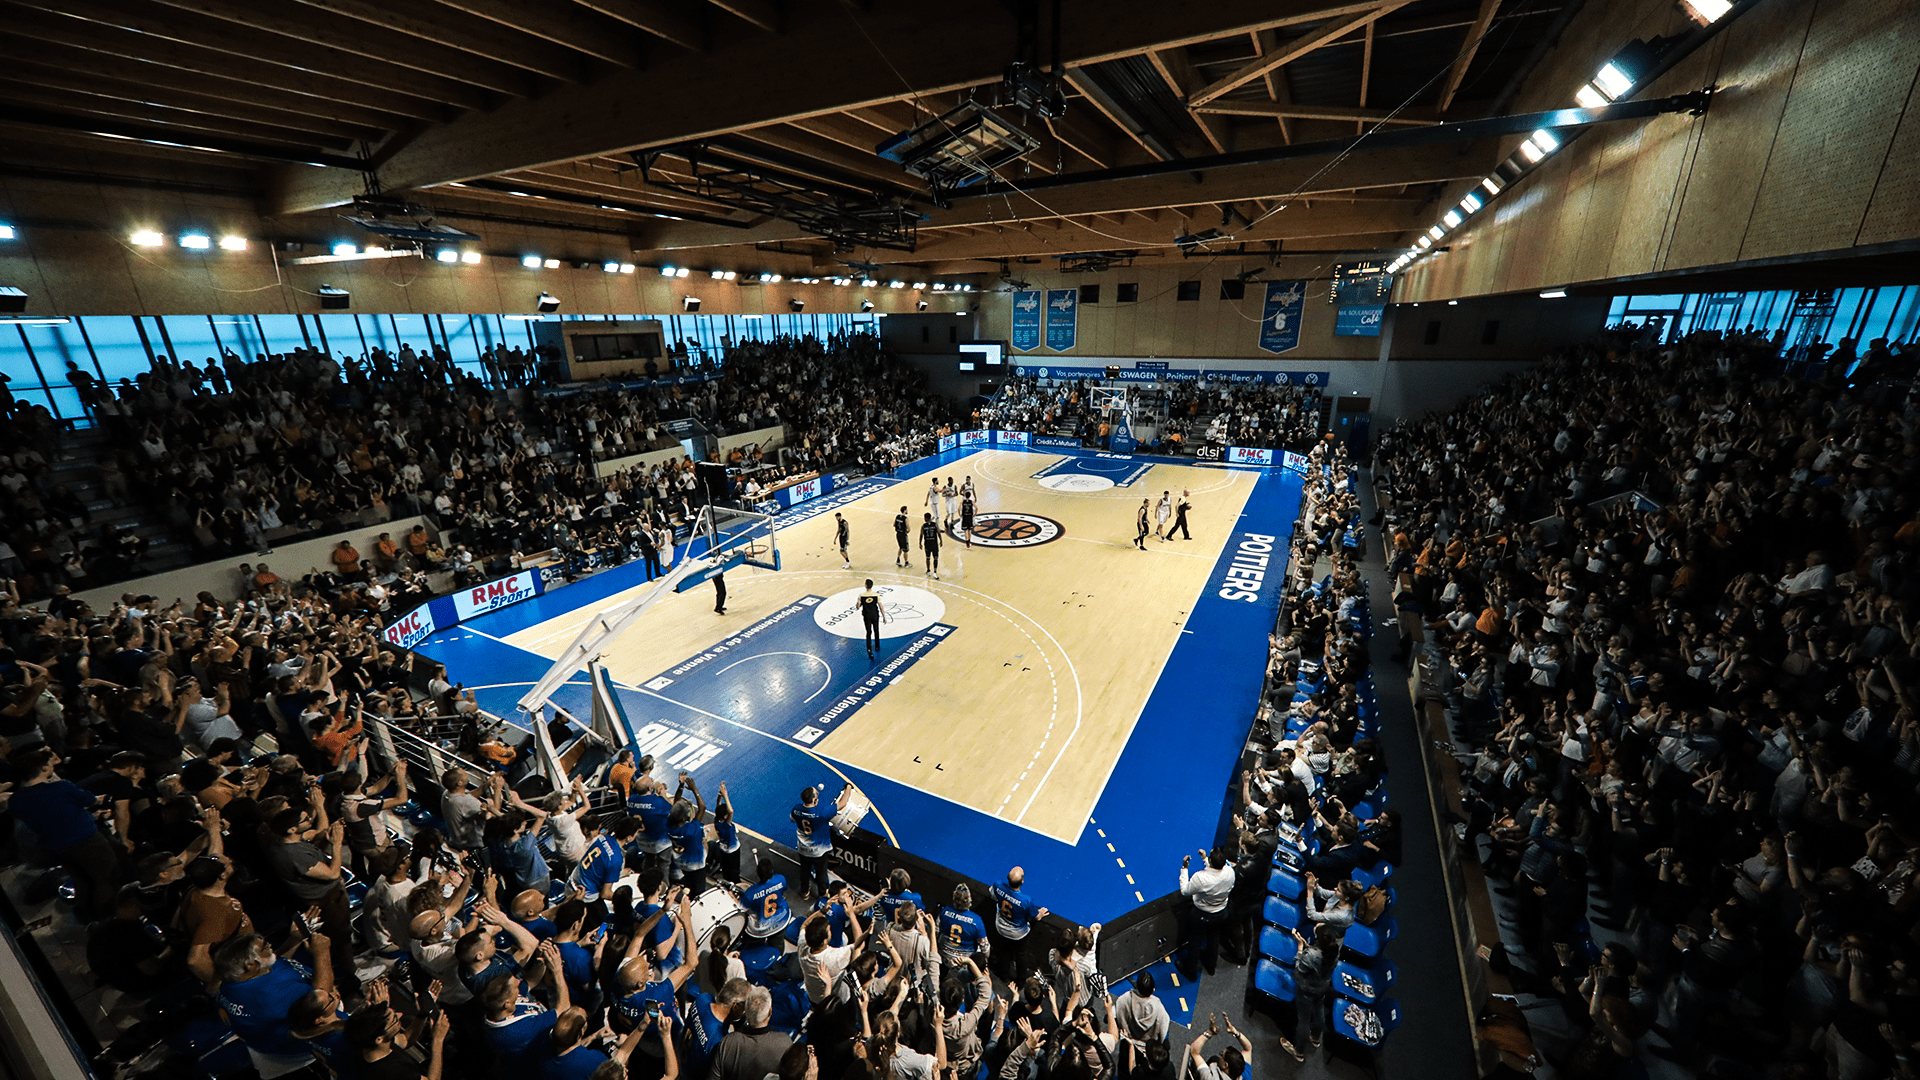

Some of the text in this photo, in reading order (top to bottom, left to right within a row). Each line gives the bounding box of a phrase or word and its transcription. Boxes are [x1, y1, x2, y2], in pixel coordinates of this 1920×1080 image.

[1275, 313, 1286, 330] 6
[1361, 314, 1380, 325] Café
[1056, 369, 1067, 377] Vos
[1068, 370, 1100, 379] partenaires
[1102, 371, 1157, 379] VKSWAGEN
[966, 430, 984, 440] RMC
[1003, 432, 1022, 441] RMC
[1196, 446, 1219, 457] dlsi
[1239, 448, 1264, 459] RMC
[1244, 456, 1270, 464] SPORT
[1289, 453, 1305, 466] RMC
[796, 481, 815, 496] RMC
[837, 484, 887, 503] GRAND
[765, 501, 842, 530] POITIERS
[1219, 533, 1276, 603] POITIERS
[472, 576, 519, 606] RMC
[490, 587, 532, 610] SPORT
[387, 611, 421, 644] RMC
[403, 622, 431, 650] SPORT
[672, 605, 803, 676] Département de la Vienne
[818, 636, 936, 724] Département de la Vienne
[801, 819, 813, 835] 6
[581, 847, 602, 870] 6
[830, 846, 878, 874] zon.fr
[752, 889, 766, 901] ALLEZ
[764, 893, 778, 919] 6
[1001, 900, 1013, 919] 6
